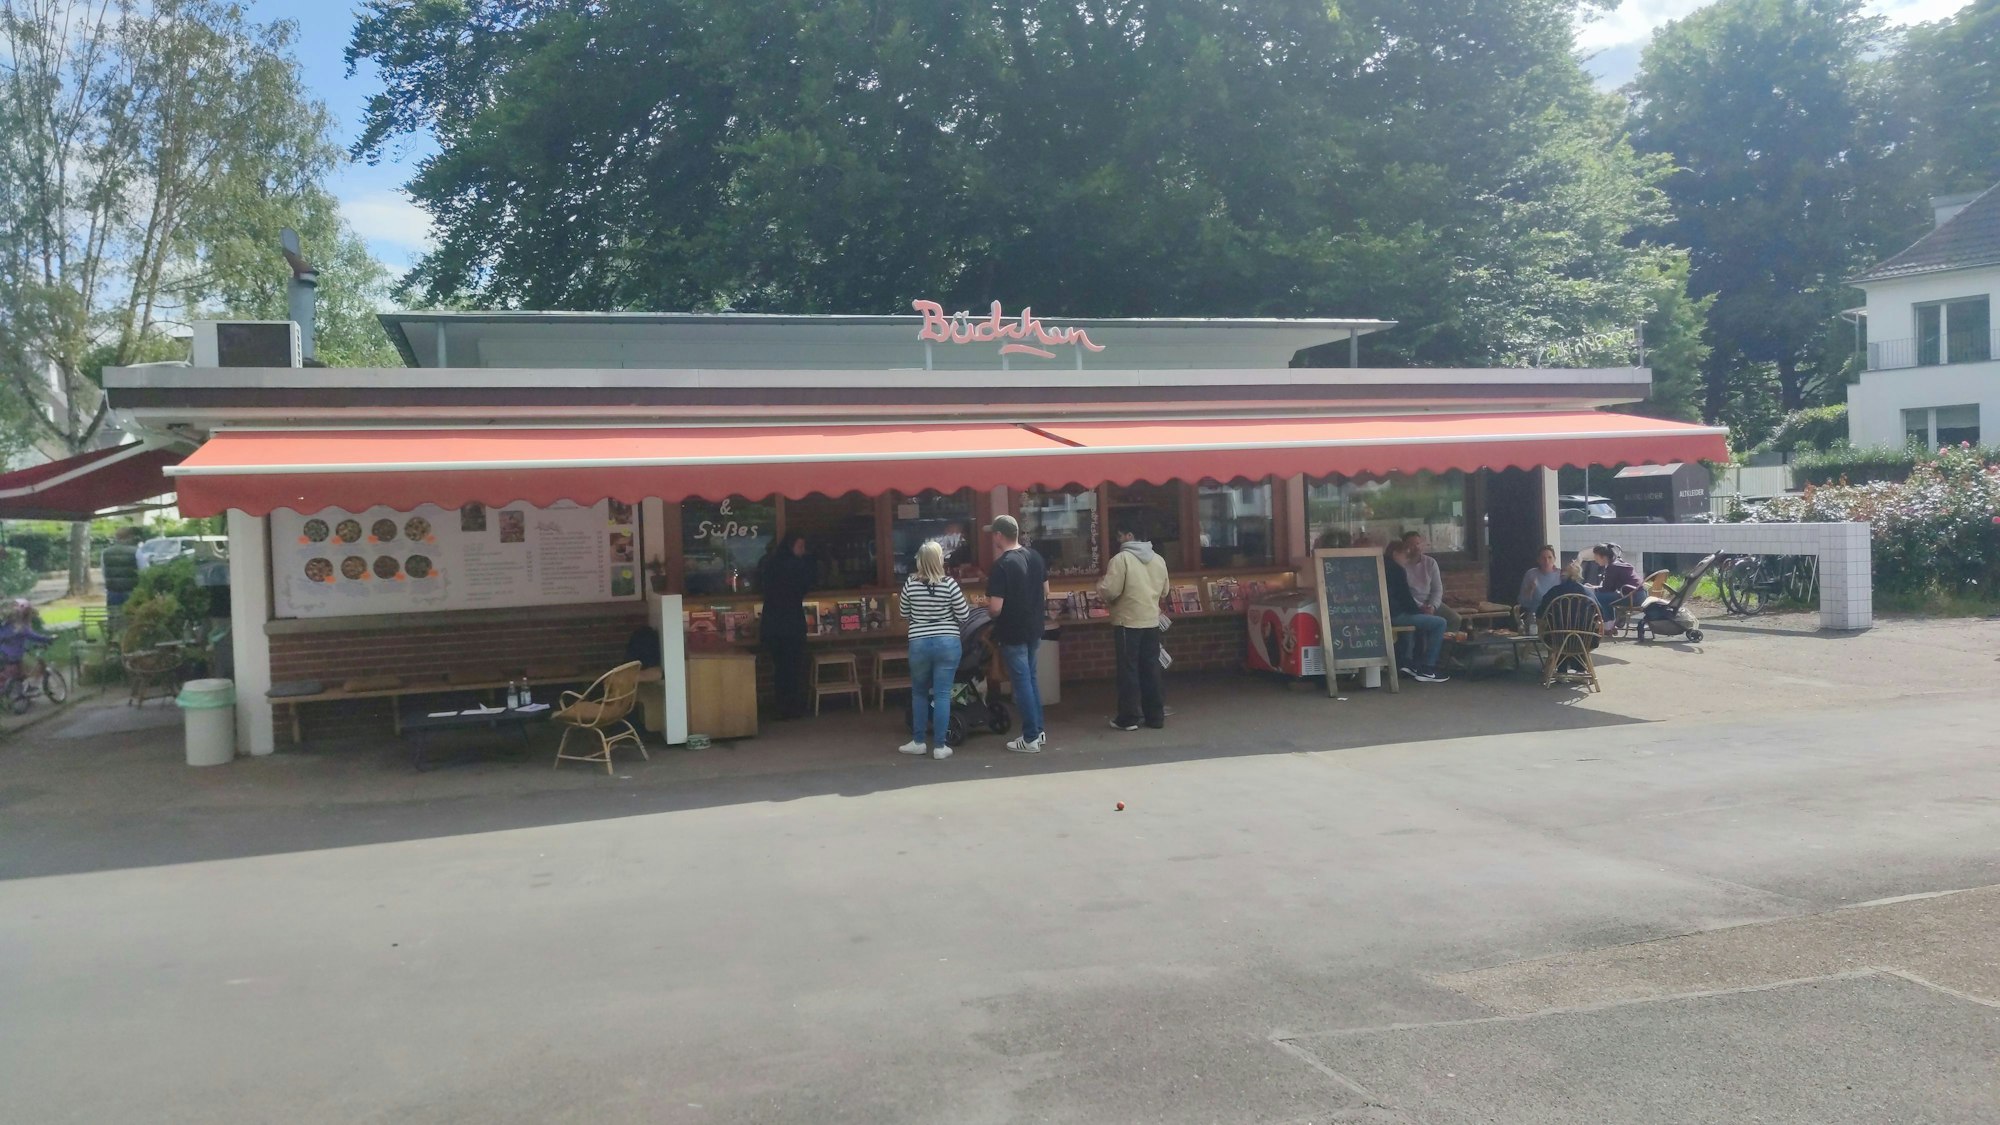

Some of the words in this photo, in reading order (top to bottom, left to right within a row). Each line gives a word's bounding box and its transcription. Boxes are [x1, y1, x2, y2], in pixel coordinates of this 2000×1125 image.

[911, 299, 1107, 352] Büdchen
[1679, 488, 1705, 498] ALTKLEIDER
[720, 498, 733, 516] &
[694, 520, 759, 540] Süßes
